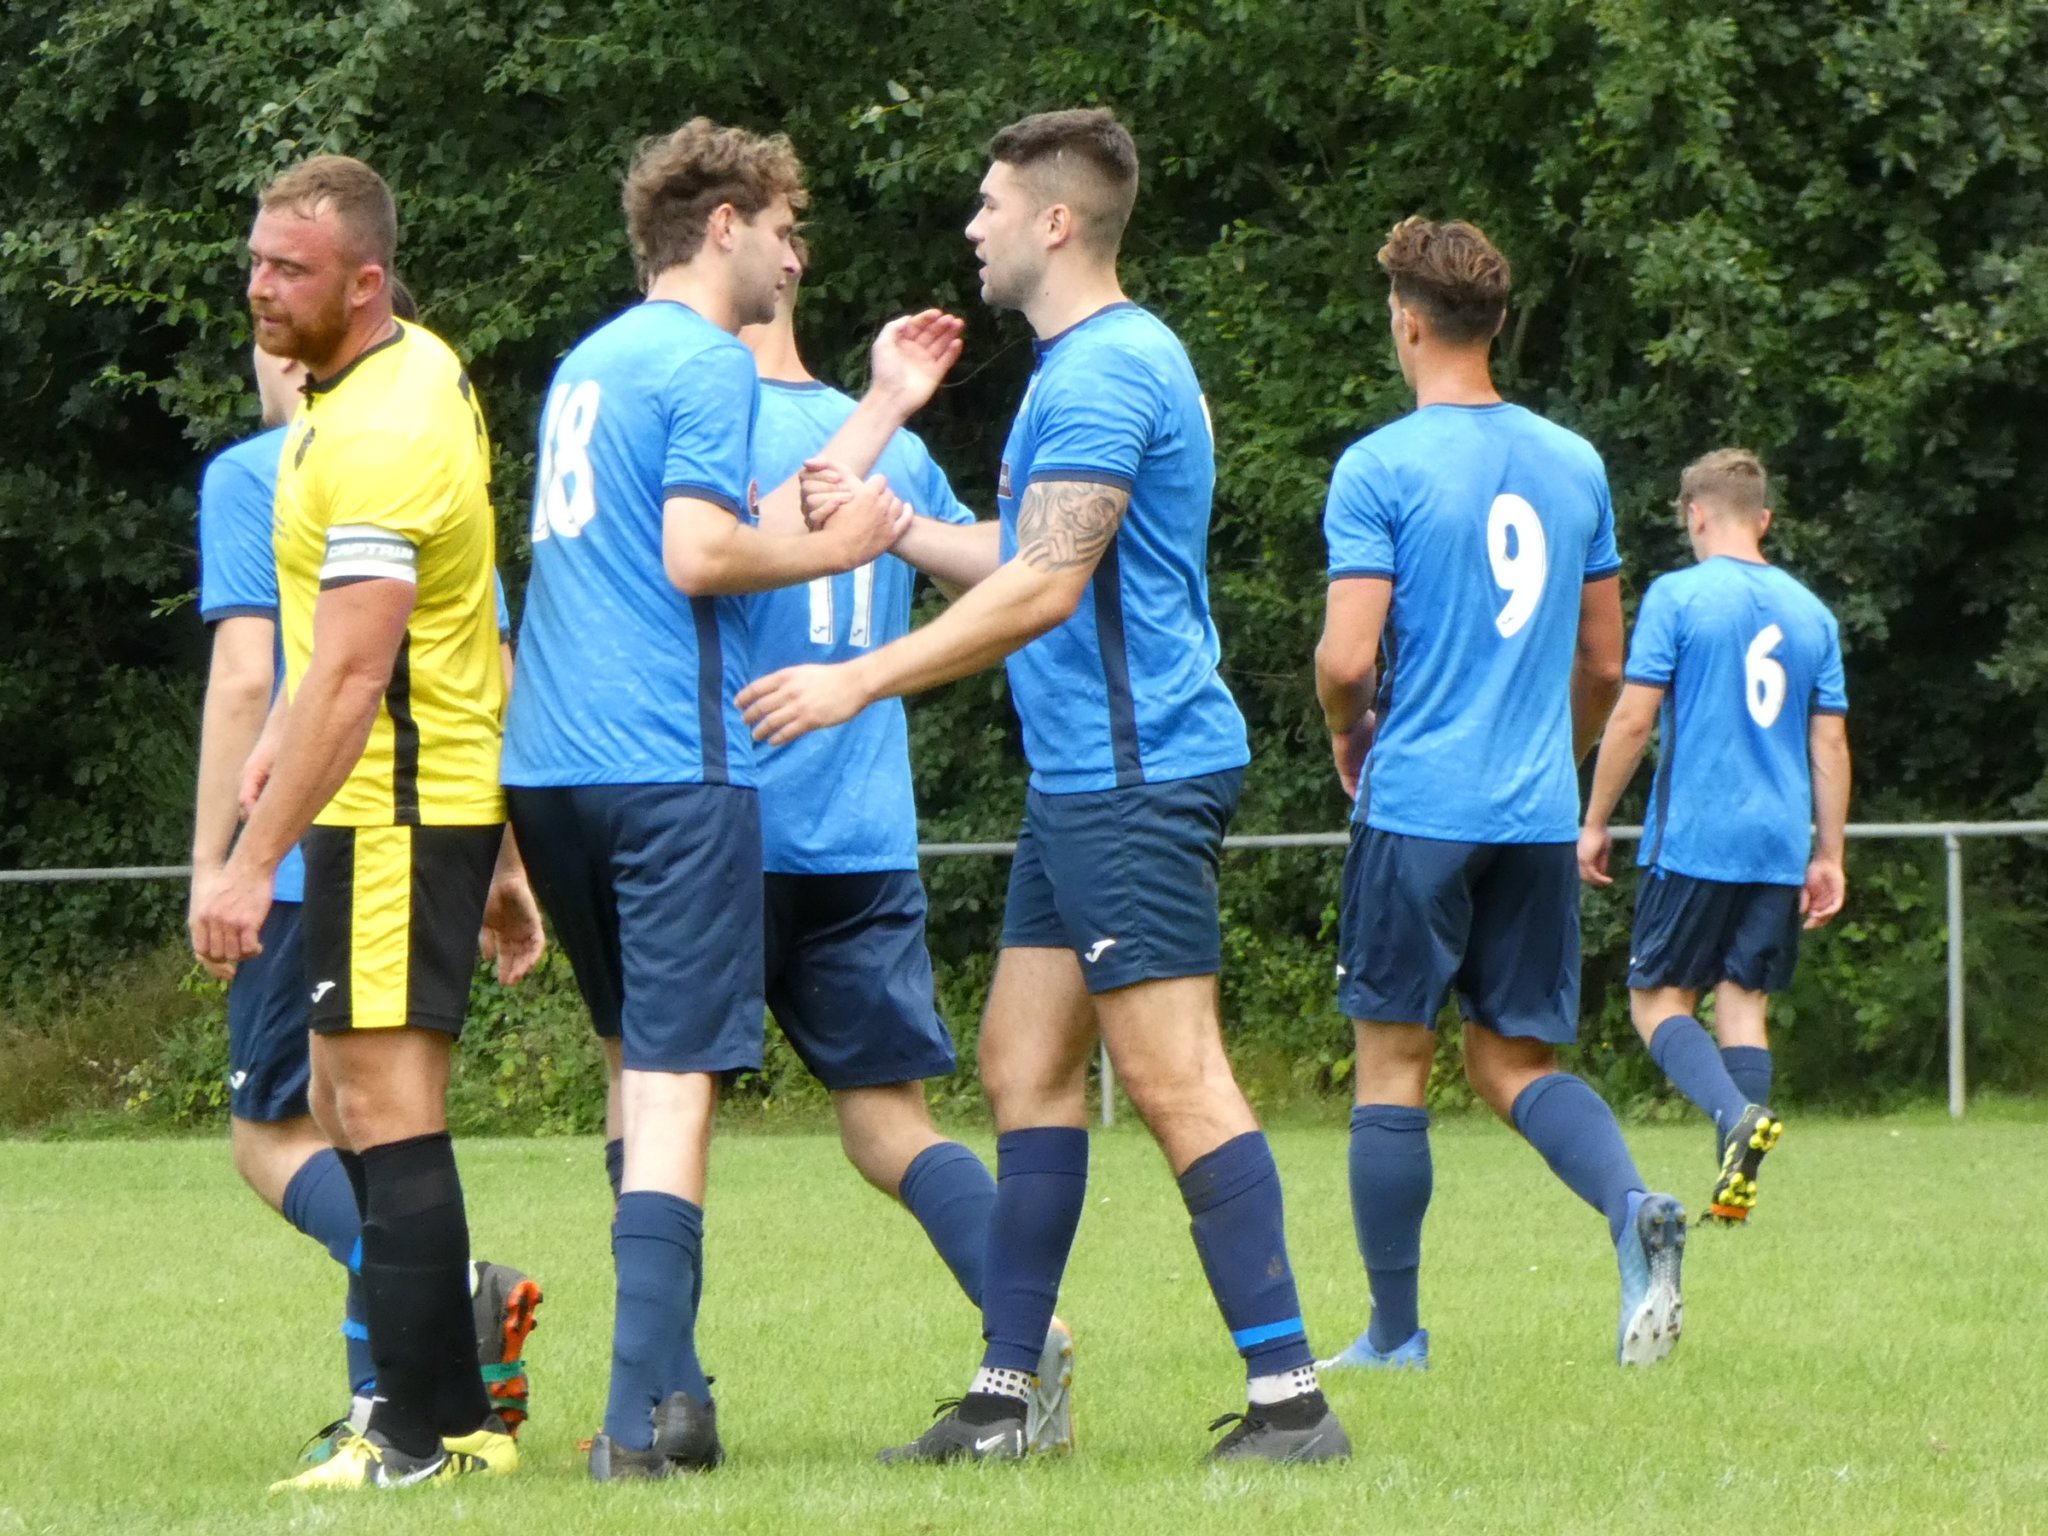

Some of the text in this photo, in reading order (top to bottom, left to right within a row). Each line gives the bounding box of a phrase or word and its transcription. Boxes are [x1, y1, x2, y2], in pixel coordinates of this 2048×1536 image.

[531, 380, 600, 542] 18
[1487, 493, 1546, 638] 9
[1745, 623, 1787, 729] 6
